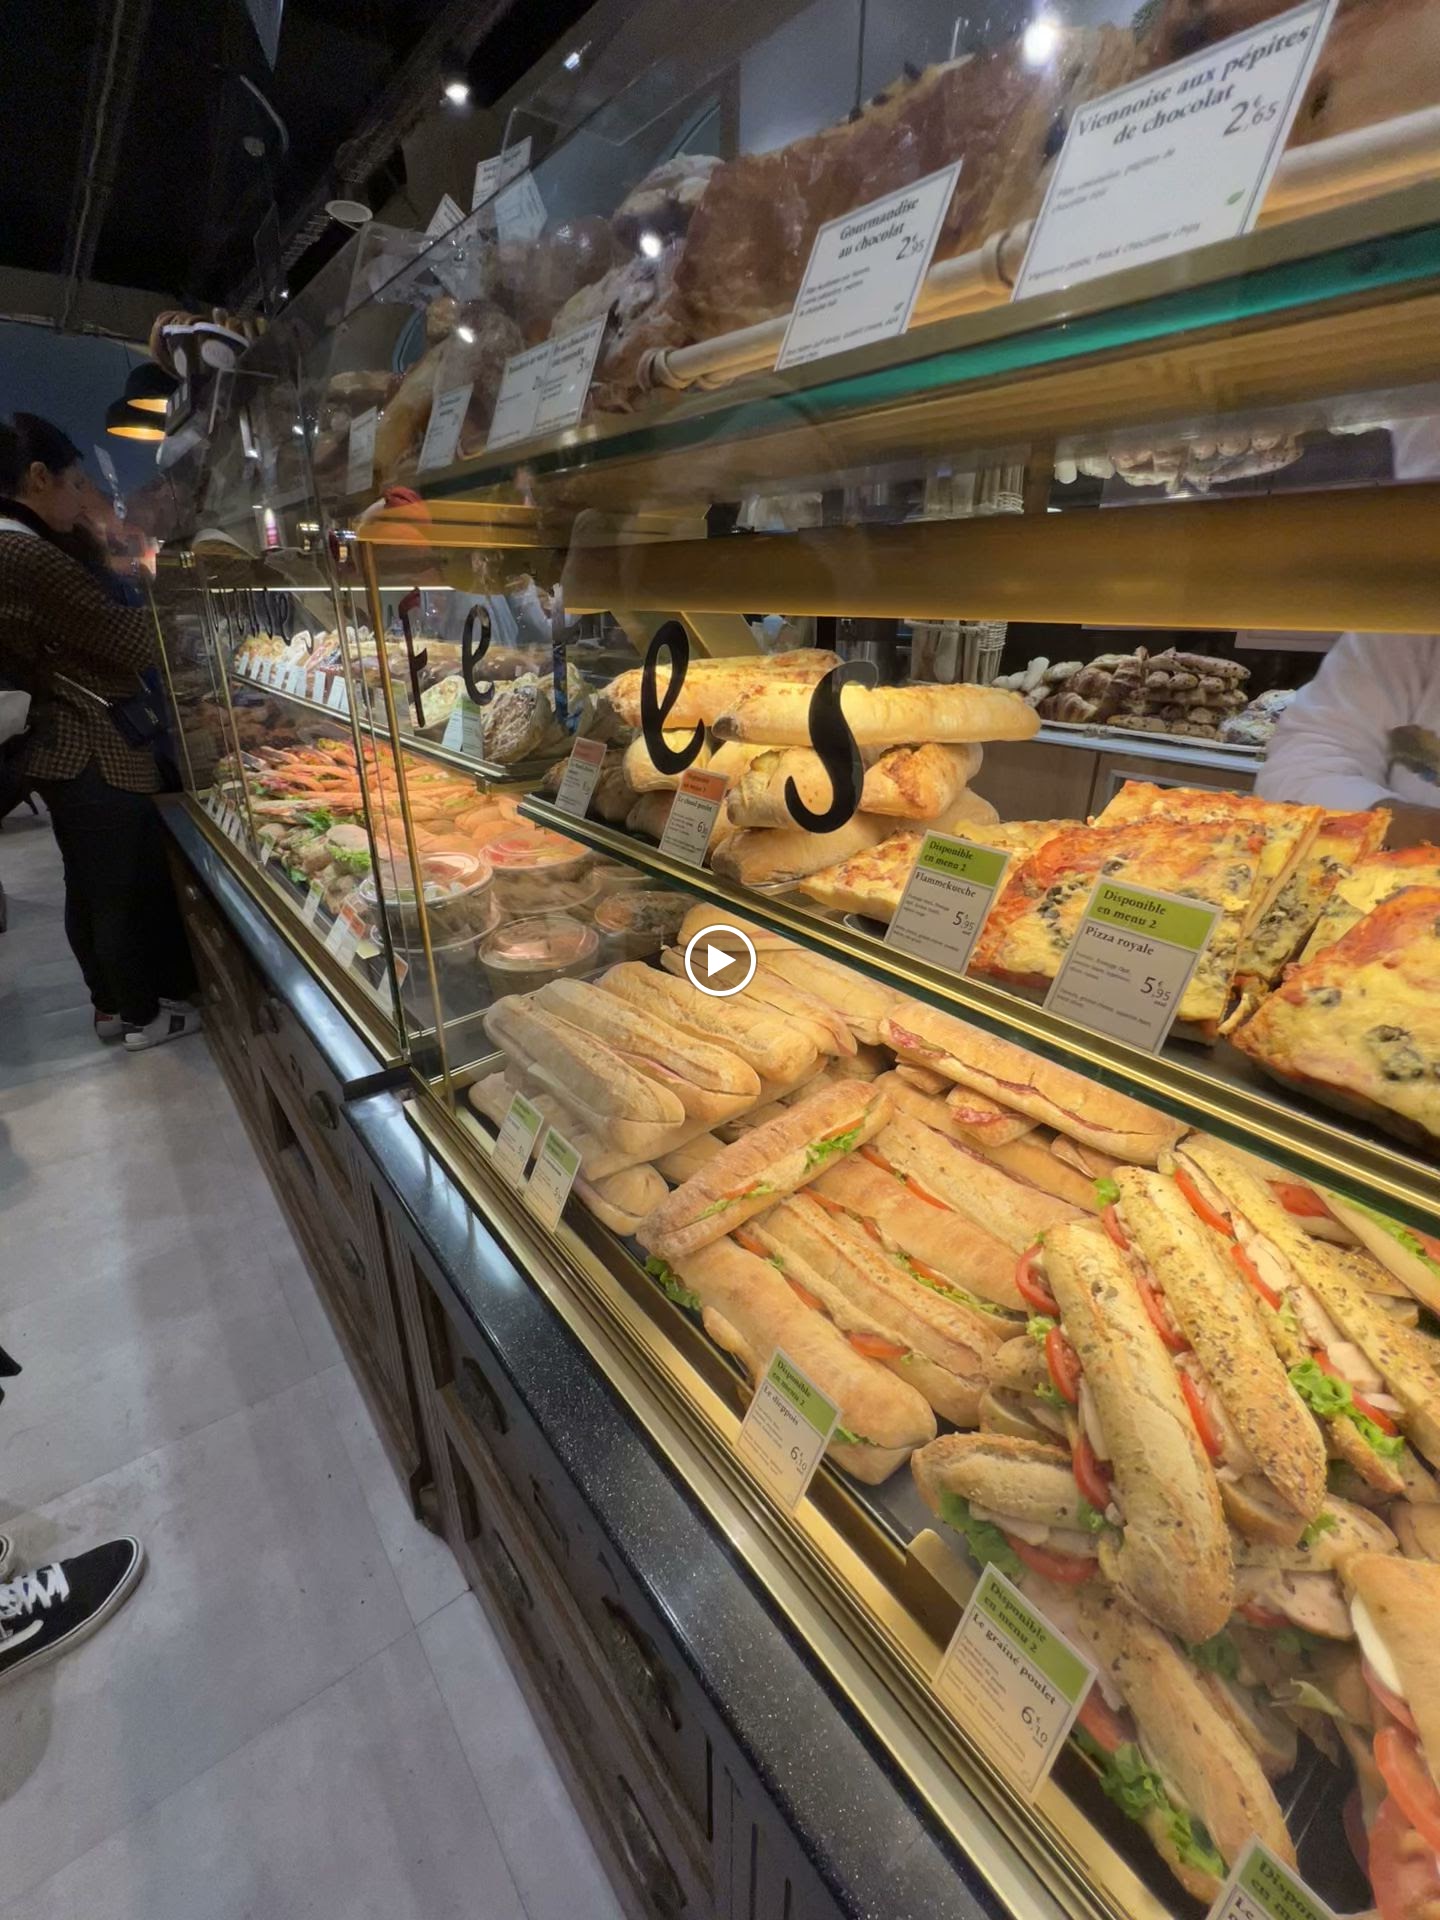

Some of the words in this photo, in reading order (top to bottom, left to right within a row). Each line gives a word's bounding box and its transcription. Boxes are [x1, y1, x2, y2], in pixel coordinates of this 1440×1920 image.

[1078, 87, 1172, 136] Viennoise
[1178, 70, 1214, 93] aux
[1221, 25, 1312, 82] pépites
[1113, 124, 1136, 145] de
[1143, 84, 1235, 134] chocolat
[840, 198, 919, 240] Gourmandise
[838, 245, 852, 259] au
[855, 222, 904, 252] chocolat
[924, 853, 936, 864] en
[936, 857, 959, 870] menu
[929, 840, 974, 862] Disponible
[915, 871, 977, 899] Flammekueche
[1104, 889, 1167, 916] Disponible
[1097, 905, 1113, 917] en
[1113, 911, 1146, 928] menu
[1147, 919, 1157, 930] 2
[1085, 925, 1118, 945] Pizza
[1118, 936, 1155, 956] royale
[772, 1372, 781, 1383] en
[780, 1380, 800, 1402] menu
[777, 1360, 812, 1397] Disponible
[763, 1384, 772, 1398] Le
[772, 1394, 799, 1426] dieppois
[984, 1596, 996, 1612] en
[998, 1610, 1028, 1643] menu
[1029, 1643, 1038, 1653] 2
[990, 1581, 1047, 1643] Disponible
[973, 1613, 985, 1630] Le
[986, 1628, 1020, 1664] grainé
[1019, 1664, 1056, 1706] poulet
[1251, 1879, 1270, 1901] en
